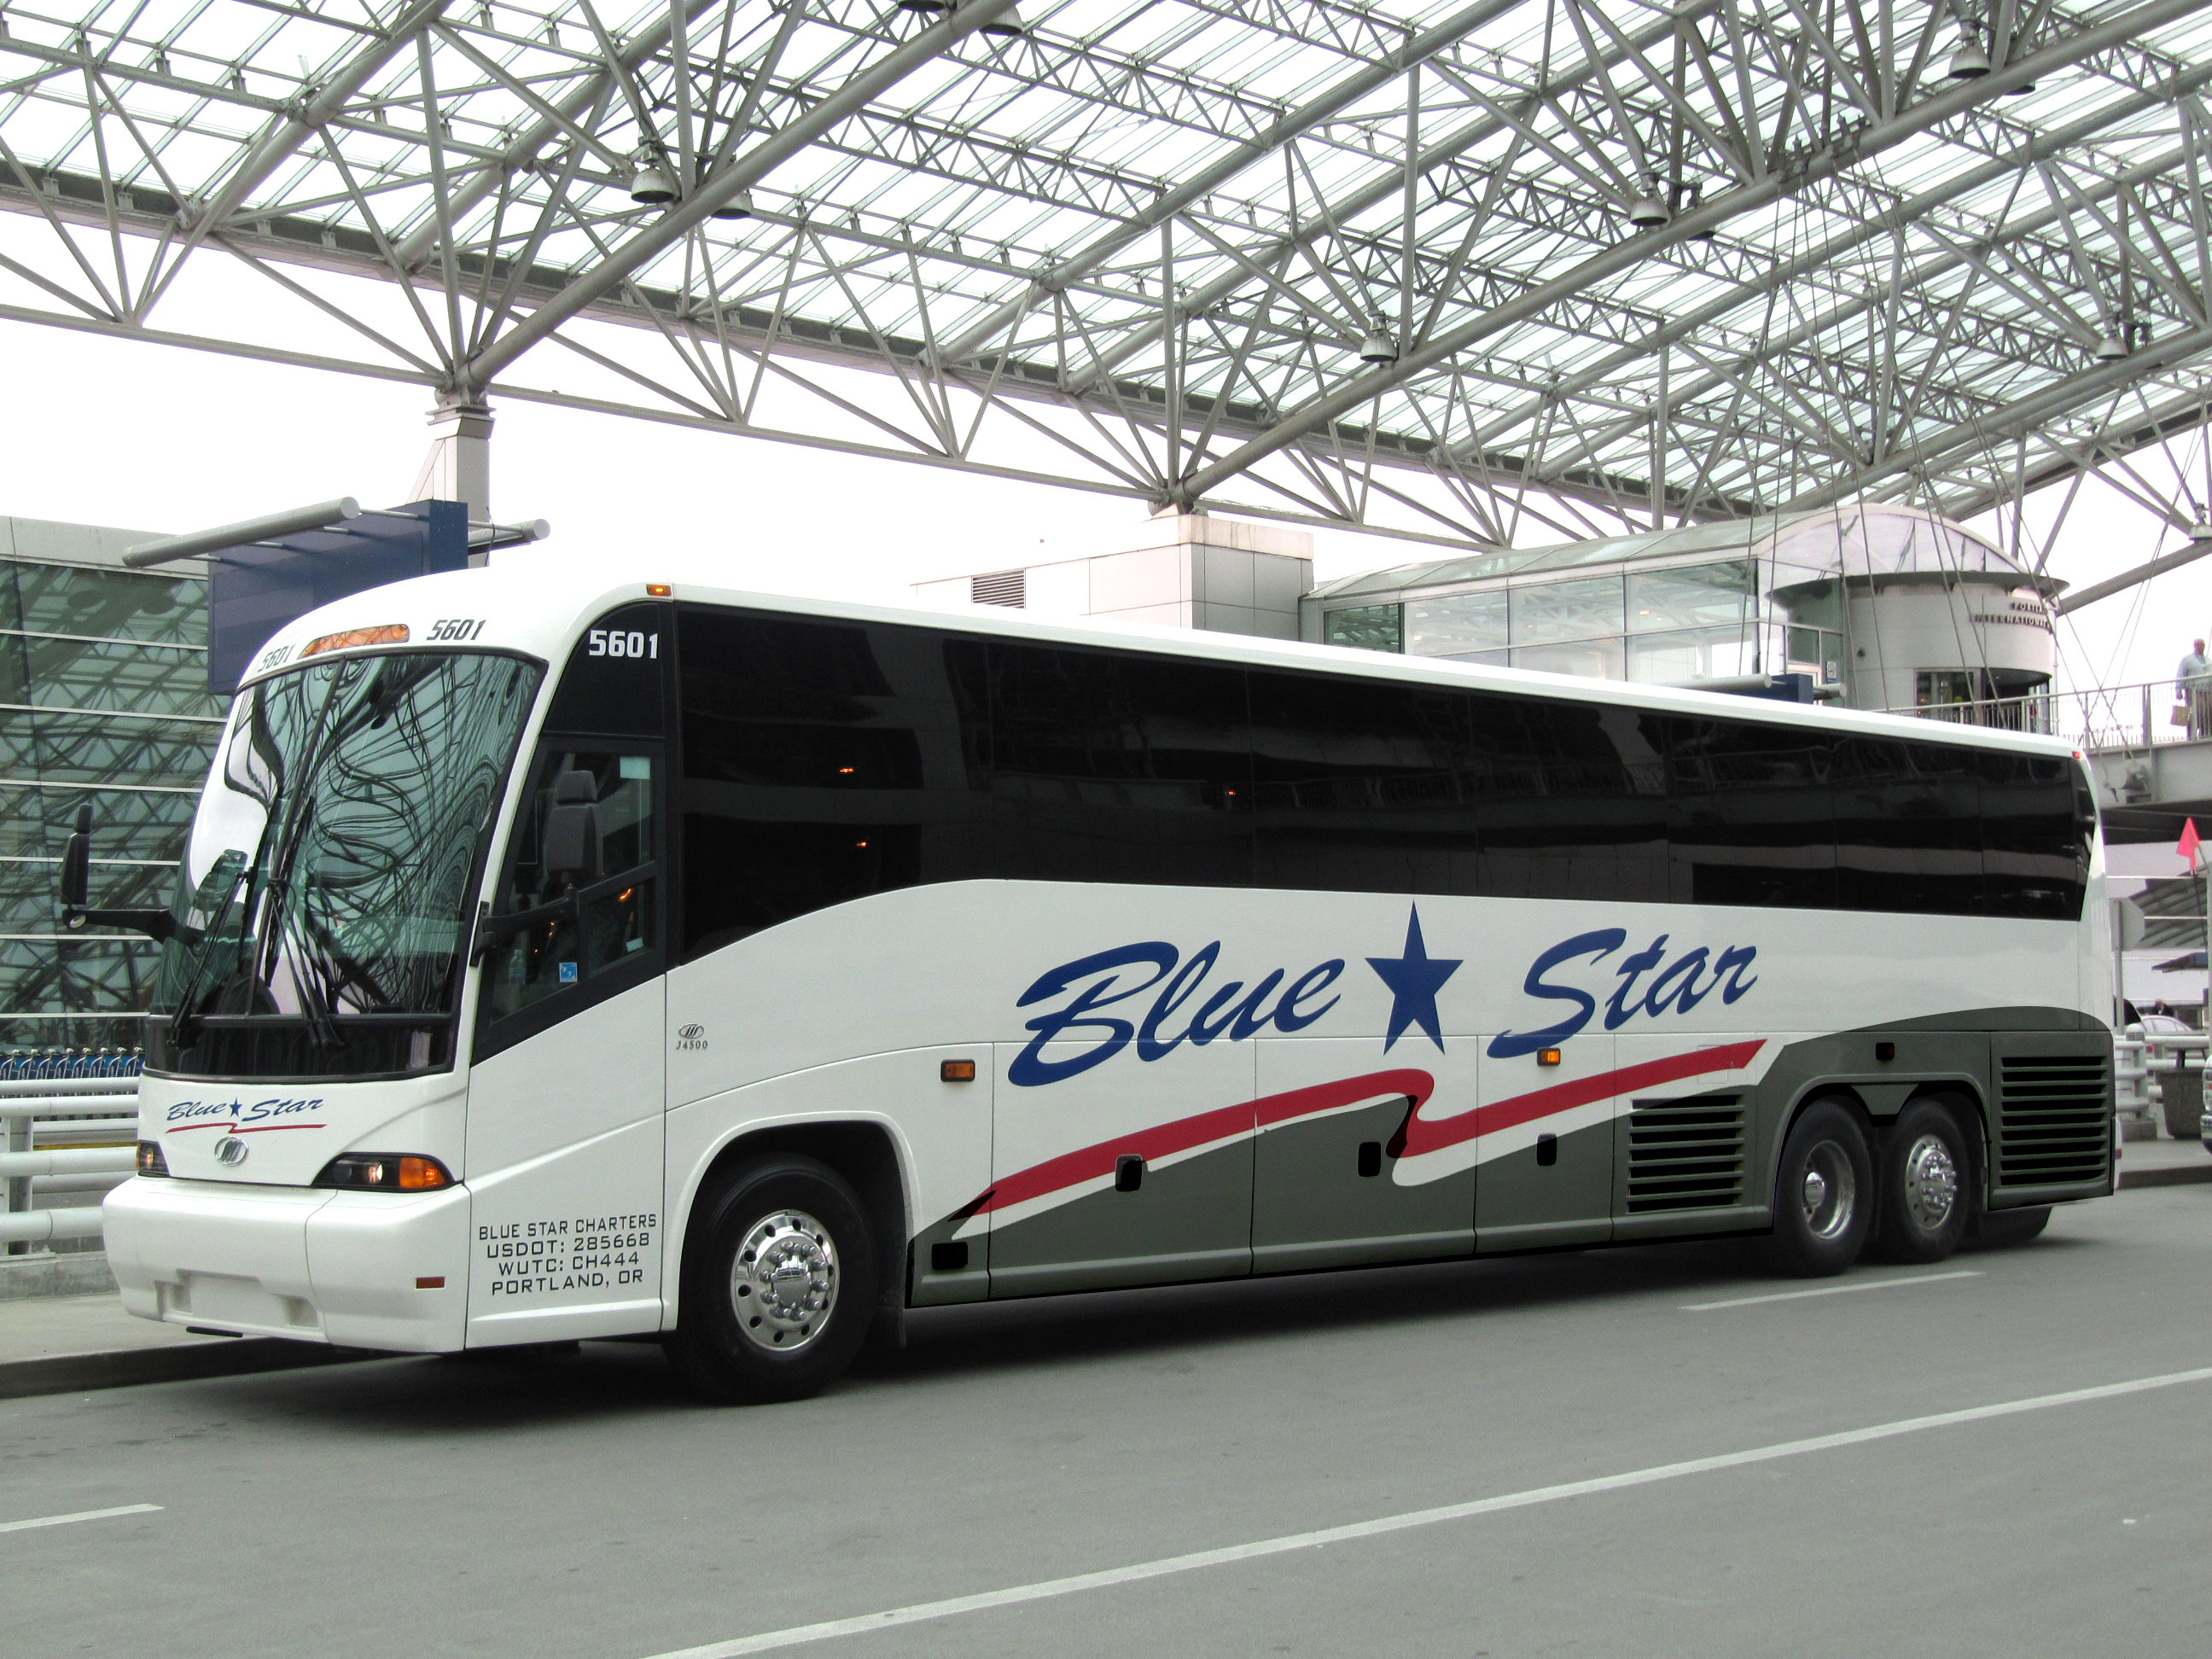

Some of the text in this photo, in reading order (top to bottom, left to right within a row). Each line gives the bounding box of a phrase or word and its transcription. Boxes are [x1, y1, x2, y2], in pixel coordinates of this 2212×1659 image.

[426, 619, 486, 641] 5601
[258, 643, 296, 672] 5601
[589, 630, 659, 659] 5601
[1007, 927, 1758, 1087] Blue Star
[676, 1040, 708, 1051] J4500
[166, 1098, 324, 1121] Blue Star
[479, 1214, 657, 1241] BLUE STAR CHARTERS
[486, 1232, 650, 1259] USDOT: 285668
[498, 1251, 640, 1277] WUTC: CH444
[492, 1268, 643, 1296] PORTLAND, OR
